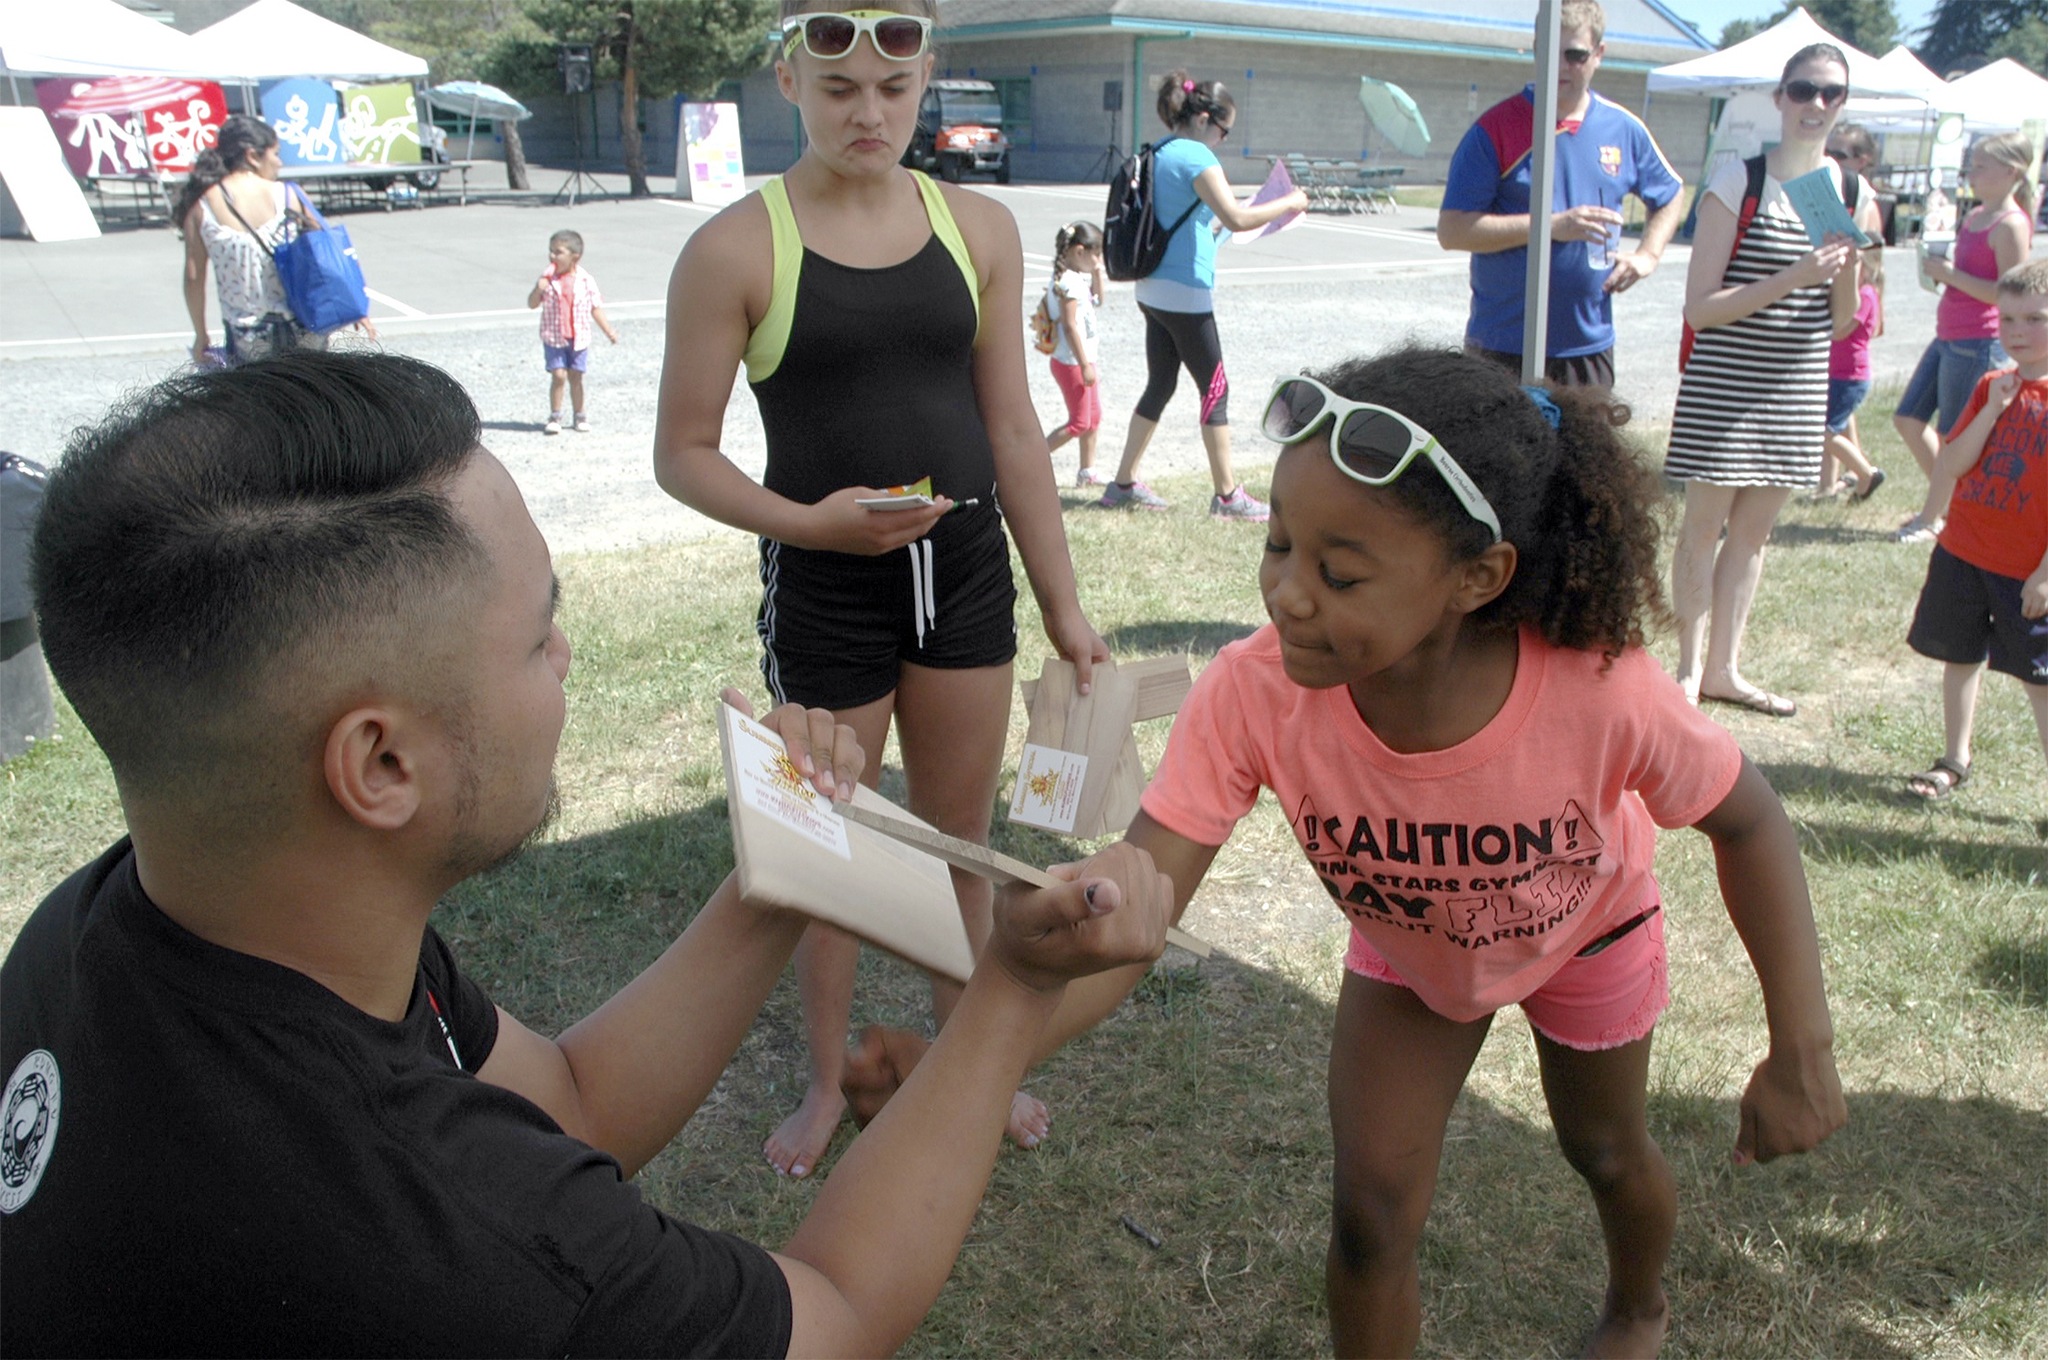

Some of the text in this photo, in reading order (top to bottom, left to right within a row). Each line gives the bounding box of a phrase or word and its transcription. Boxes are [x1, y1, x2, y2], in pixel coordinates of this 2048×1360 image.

[1988, 426, 2048, 456] ACON
[1323, 815, 1553, 866] CAUTION
[1372, 873, 1460, 893] STARS
[1444, 876, 1592, 949] WARNING!!!
